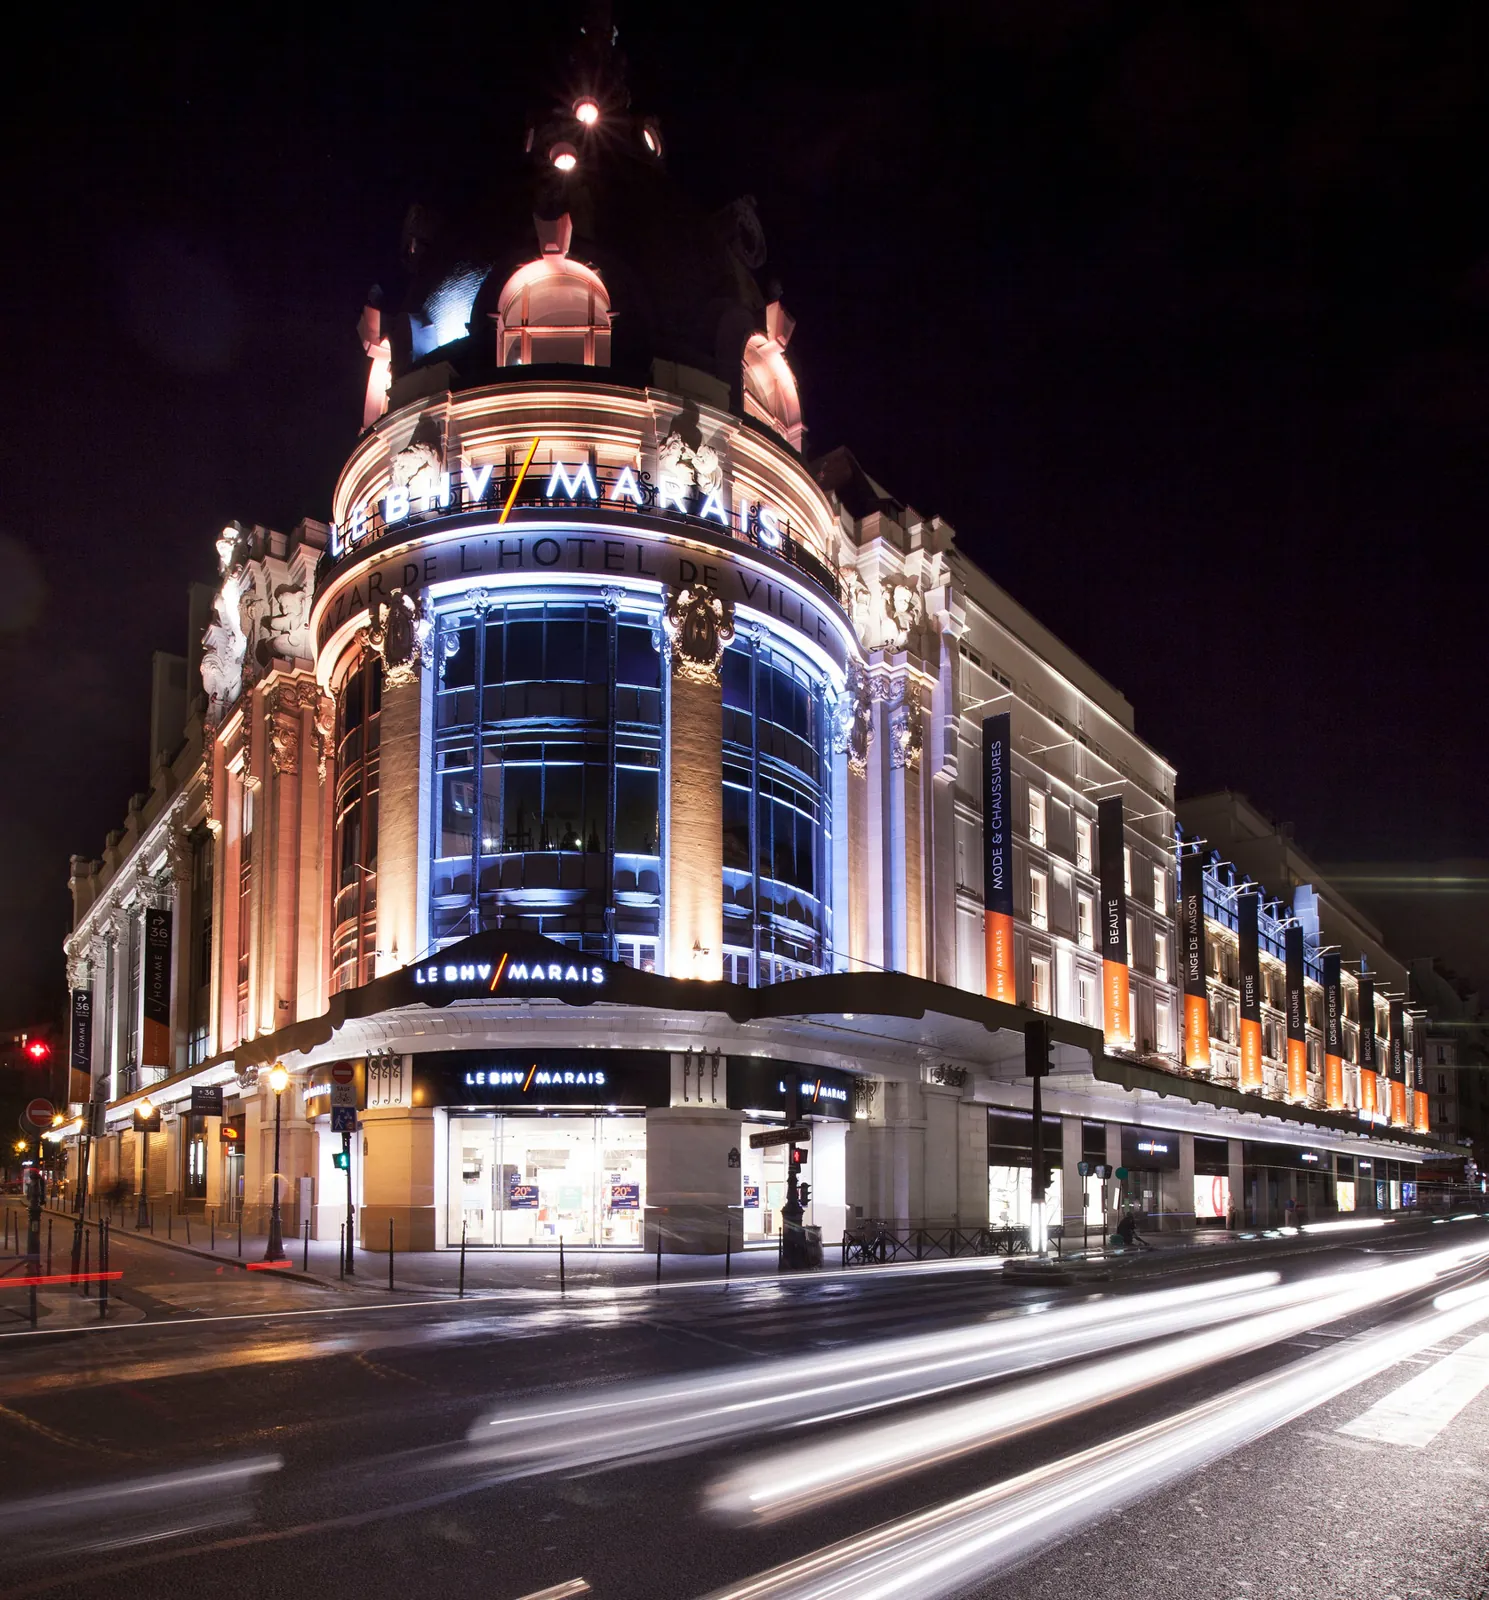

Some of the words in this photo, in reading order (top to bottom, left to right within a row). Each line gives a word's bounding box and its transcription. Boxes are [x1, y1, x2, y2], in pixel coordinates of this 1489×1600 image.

[331, 502, 368, 557] LE
[385, 464, 493, 523] BHV
[546, 460, 781, 547] MARAIS
[403, 556, 437, 588] DE
[460, 537, 656, 577] L'HOTEL
[678, 558, 718, 591] DE
[737, 570, 828, 648] VILLE
[991, 740, 1001, 830] CHAUSSURES
[992, 833, 1002, 844] &
[993, 847, 1003, 890] MODE
[1108, 899, 1119, 944] BEAUTÉ
[1188, 895, 1197, 934] MAISON
[150, 927, 168, 939] 36
[1189, 936, 1198, 950] DE
[995, 930, 1003, 967] MARAIS
[416, 966, 438, 984] LE
[445, 964, 491, 982] BHV
[508, 964, 605, 984] MARAIS
[1190, 951, 1199, 981] LINGE
[1245, 975, 1253, 1007] LITERIE
[76, 1002, 90, 1011] 36
[466, 1072, 485, 1085] LE
[489, 1072, 524, 1085] BHV
[535, 1072, 605, 1085] MARAIS
[801, 1083, 816, 1096] HV
[819, 1086, 847, 1101] MARAIS
[510, 1186, 532, 1197] -20%
[612, 1186, 632, 1197] -20%
